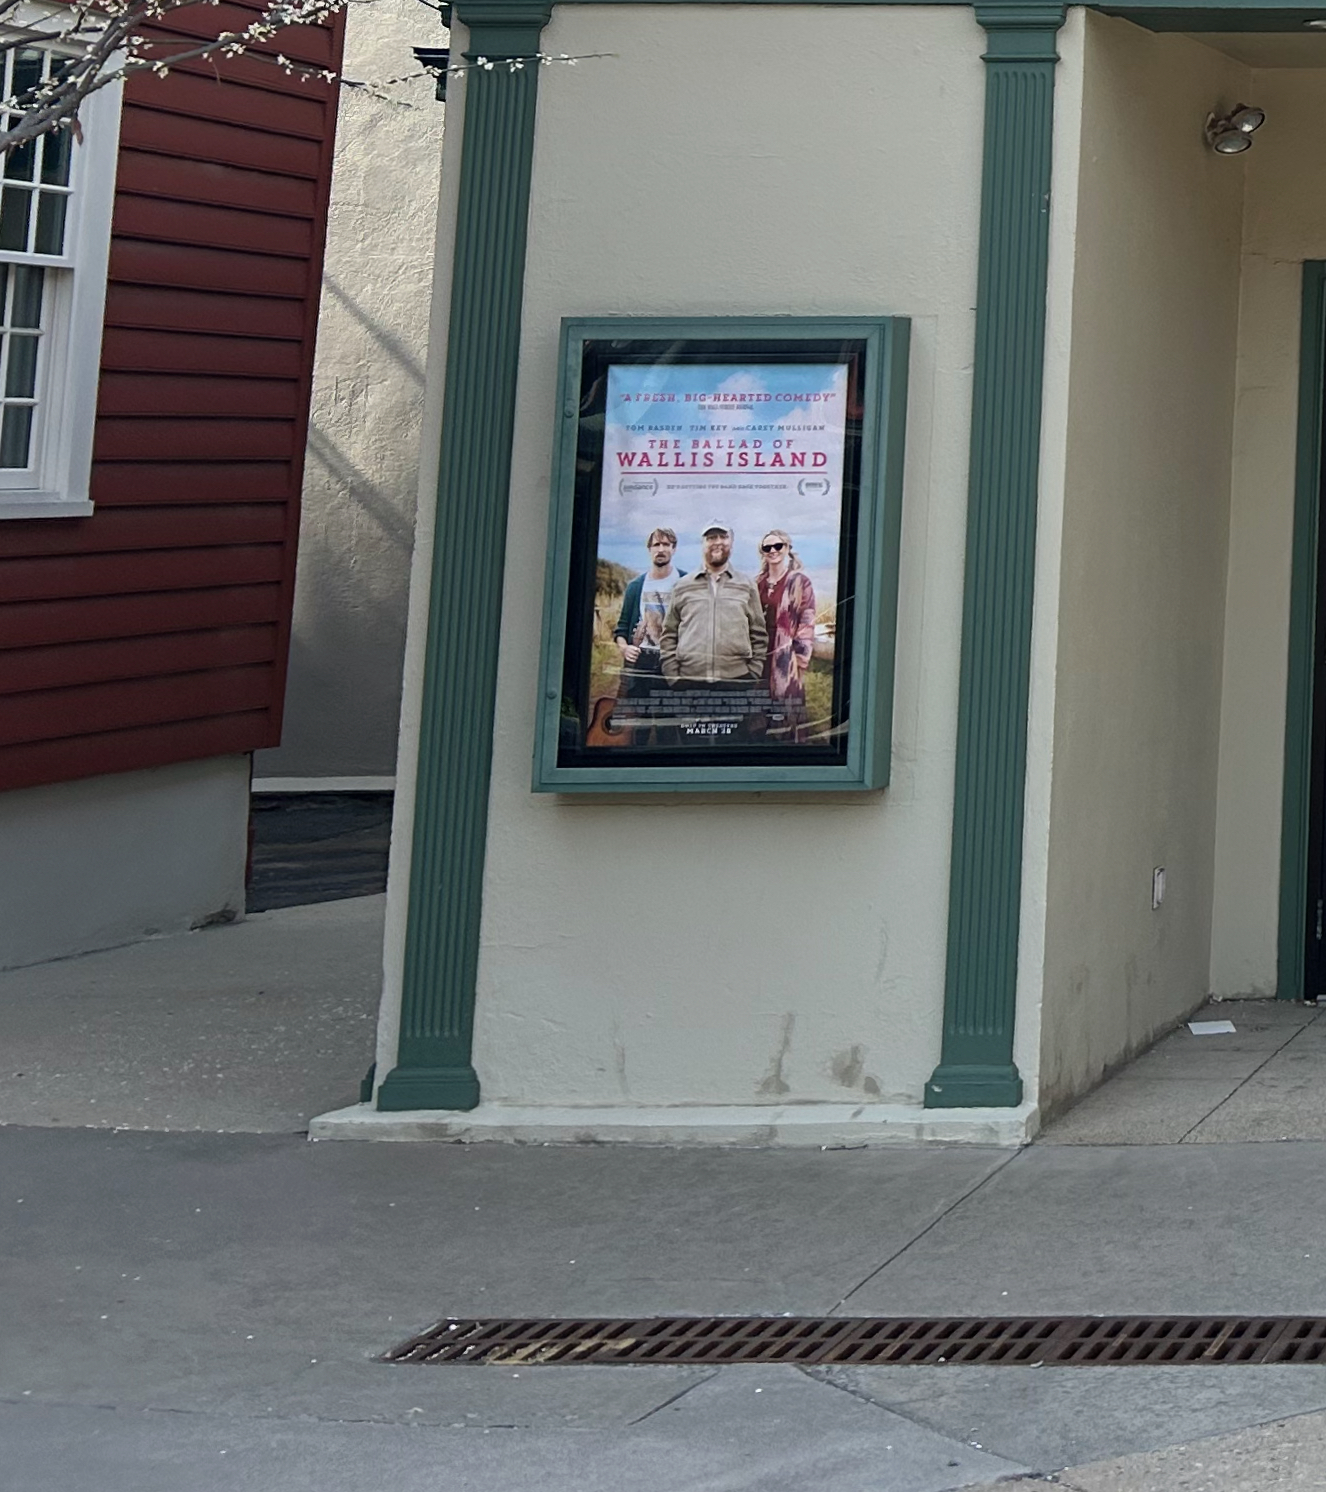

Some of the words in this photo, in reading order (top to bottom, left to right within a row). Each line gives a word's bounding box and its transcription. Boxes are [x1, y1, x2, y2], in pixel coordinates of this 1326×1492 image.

[684, 393, 772, 402] BIG-HEARTED
[648, 440, 680, 449] THE
[692, 440, 762, 449] BALLAD
[773, 440, 794, 449] OF
[616, 452, 714, 467] WALLIS
[726, 452, 827, 467] ISLAND
